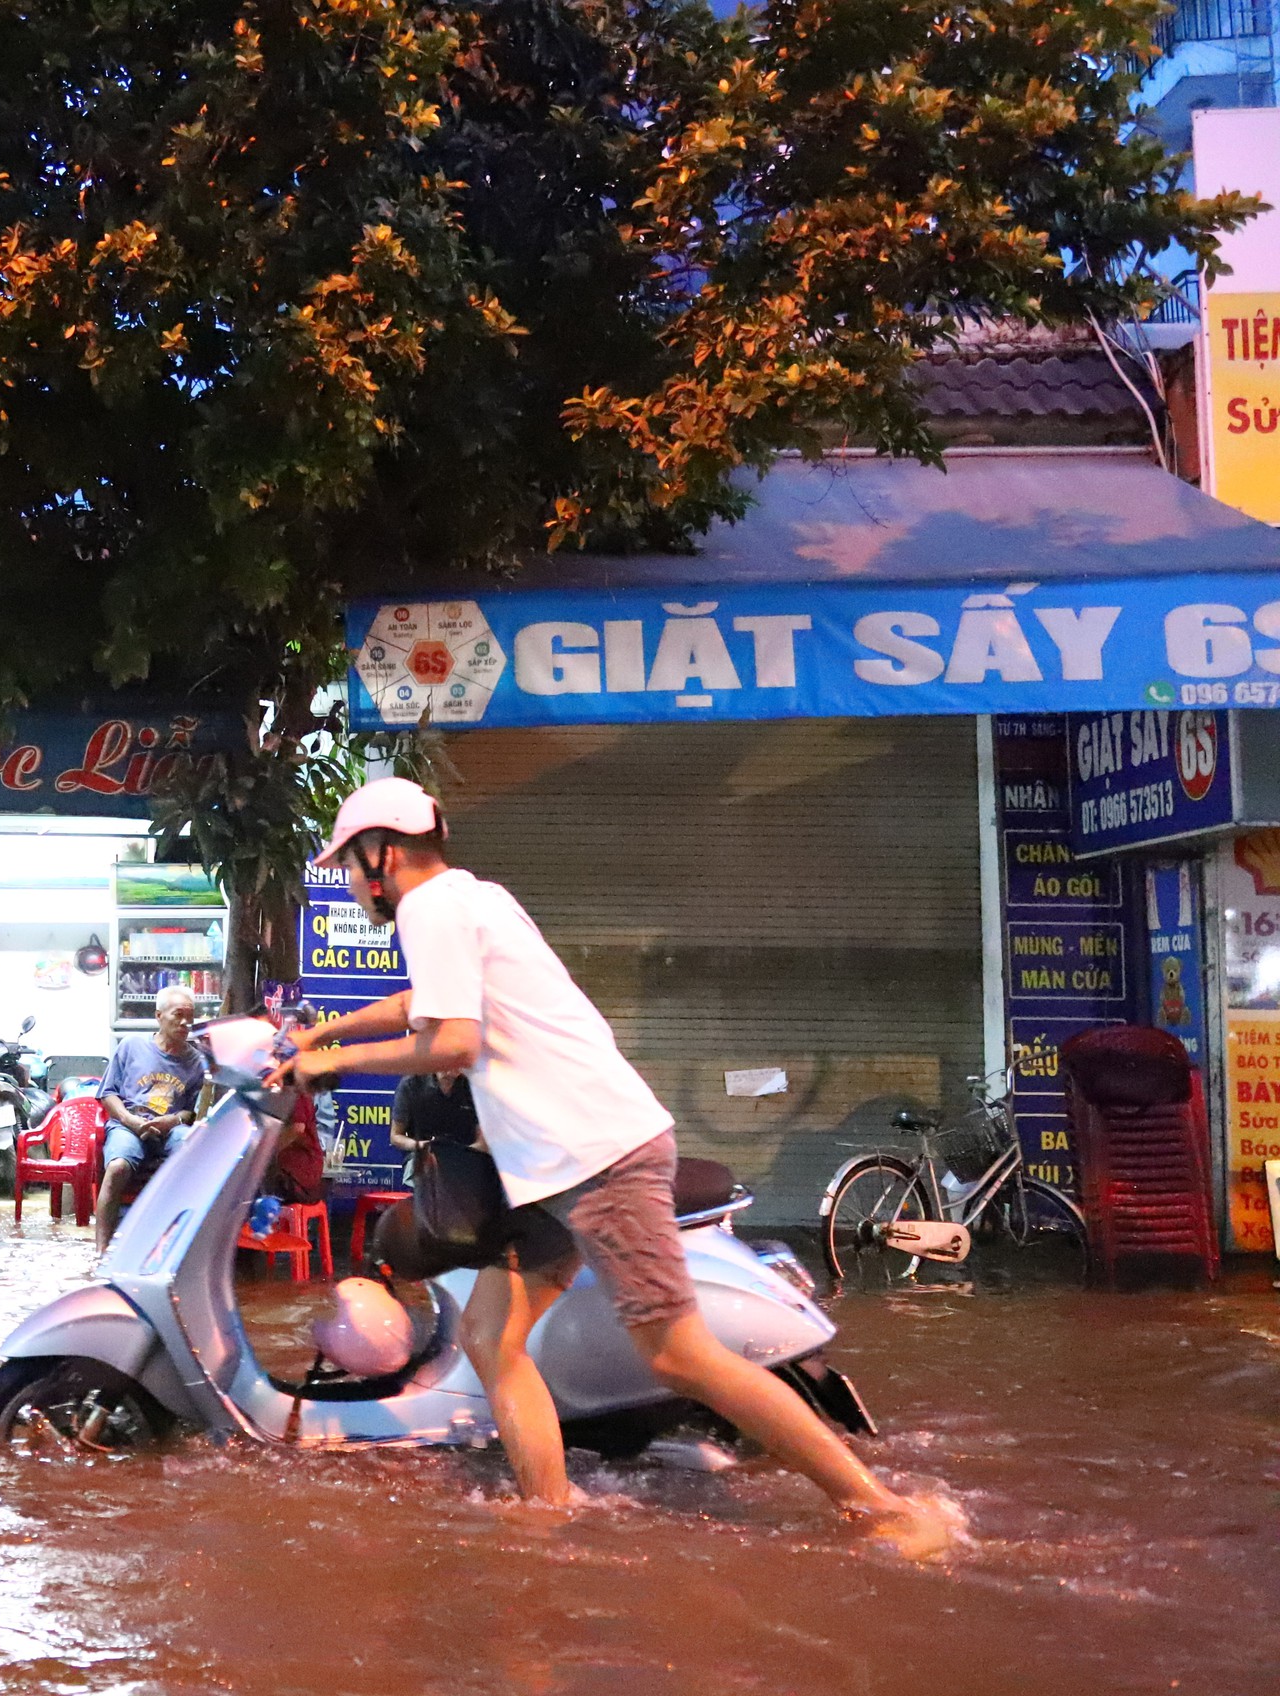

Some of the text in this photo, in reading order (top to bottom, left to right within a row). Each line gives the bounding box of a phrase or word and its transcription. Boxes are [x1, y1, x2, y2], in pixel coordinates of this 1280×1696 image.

[515, 603, 811, 707] GIẶT
[853, 583, 1122, 686] SẤY
[413, 650, 448, 676] 6S
[1181, 682, 1228, 705] 096
[1013, 722, 1026, 736] 7H
[1180, 711, 1215, 781] 6S
[1100, 792, 1128, 831] 0966
[1130, 779, 1174, 824] 573513
[1034, 873, 1061, 897] ÁO
[349, 907, 356, 919] XE
[333, 921, 358, 934] KHÔNG
[359, 924, 367, 937] BỊ
[368, 924, 387, 938] PHẠT
[1014, 931, 1063, 956] MÙNG
[311, 945, 398, 973] CÁC LOẠI
[1021, 963, 1111, 990] MÀN CỬA
[137, 1072, 186, 1093] TEAMSTER
[347, 1105, 391, 1125] SINH
[1040, 1131, 1069, 1150] BA
